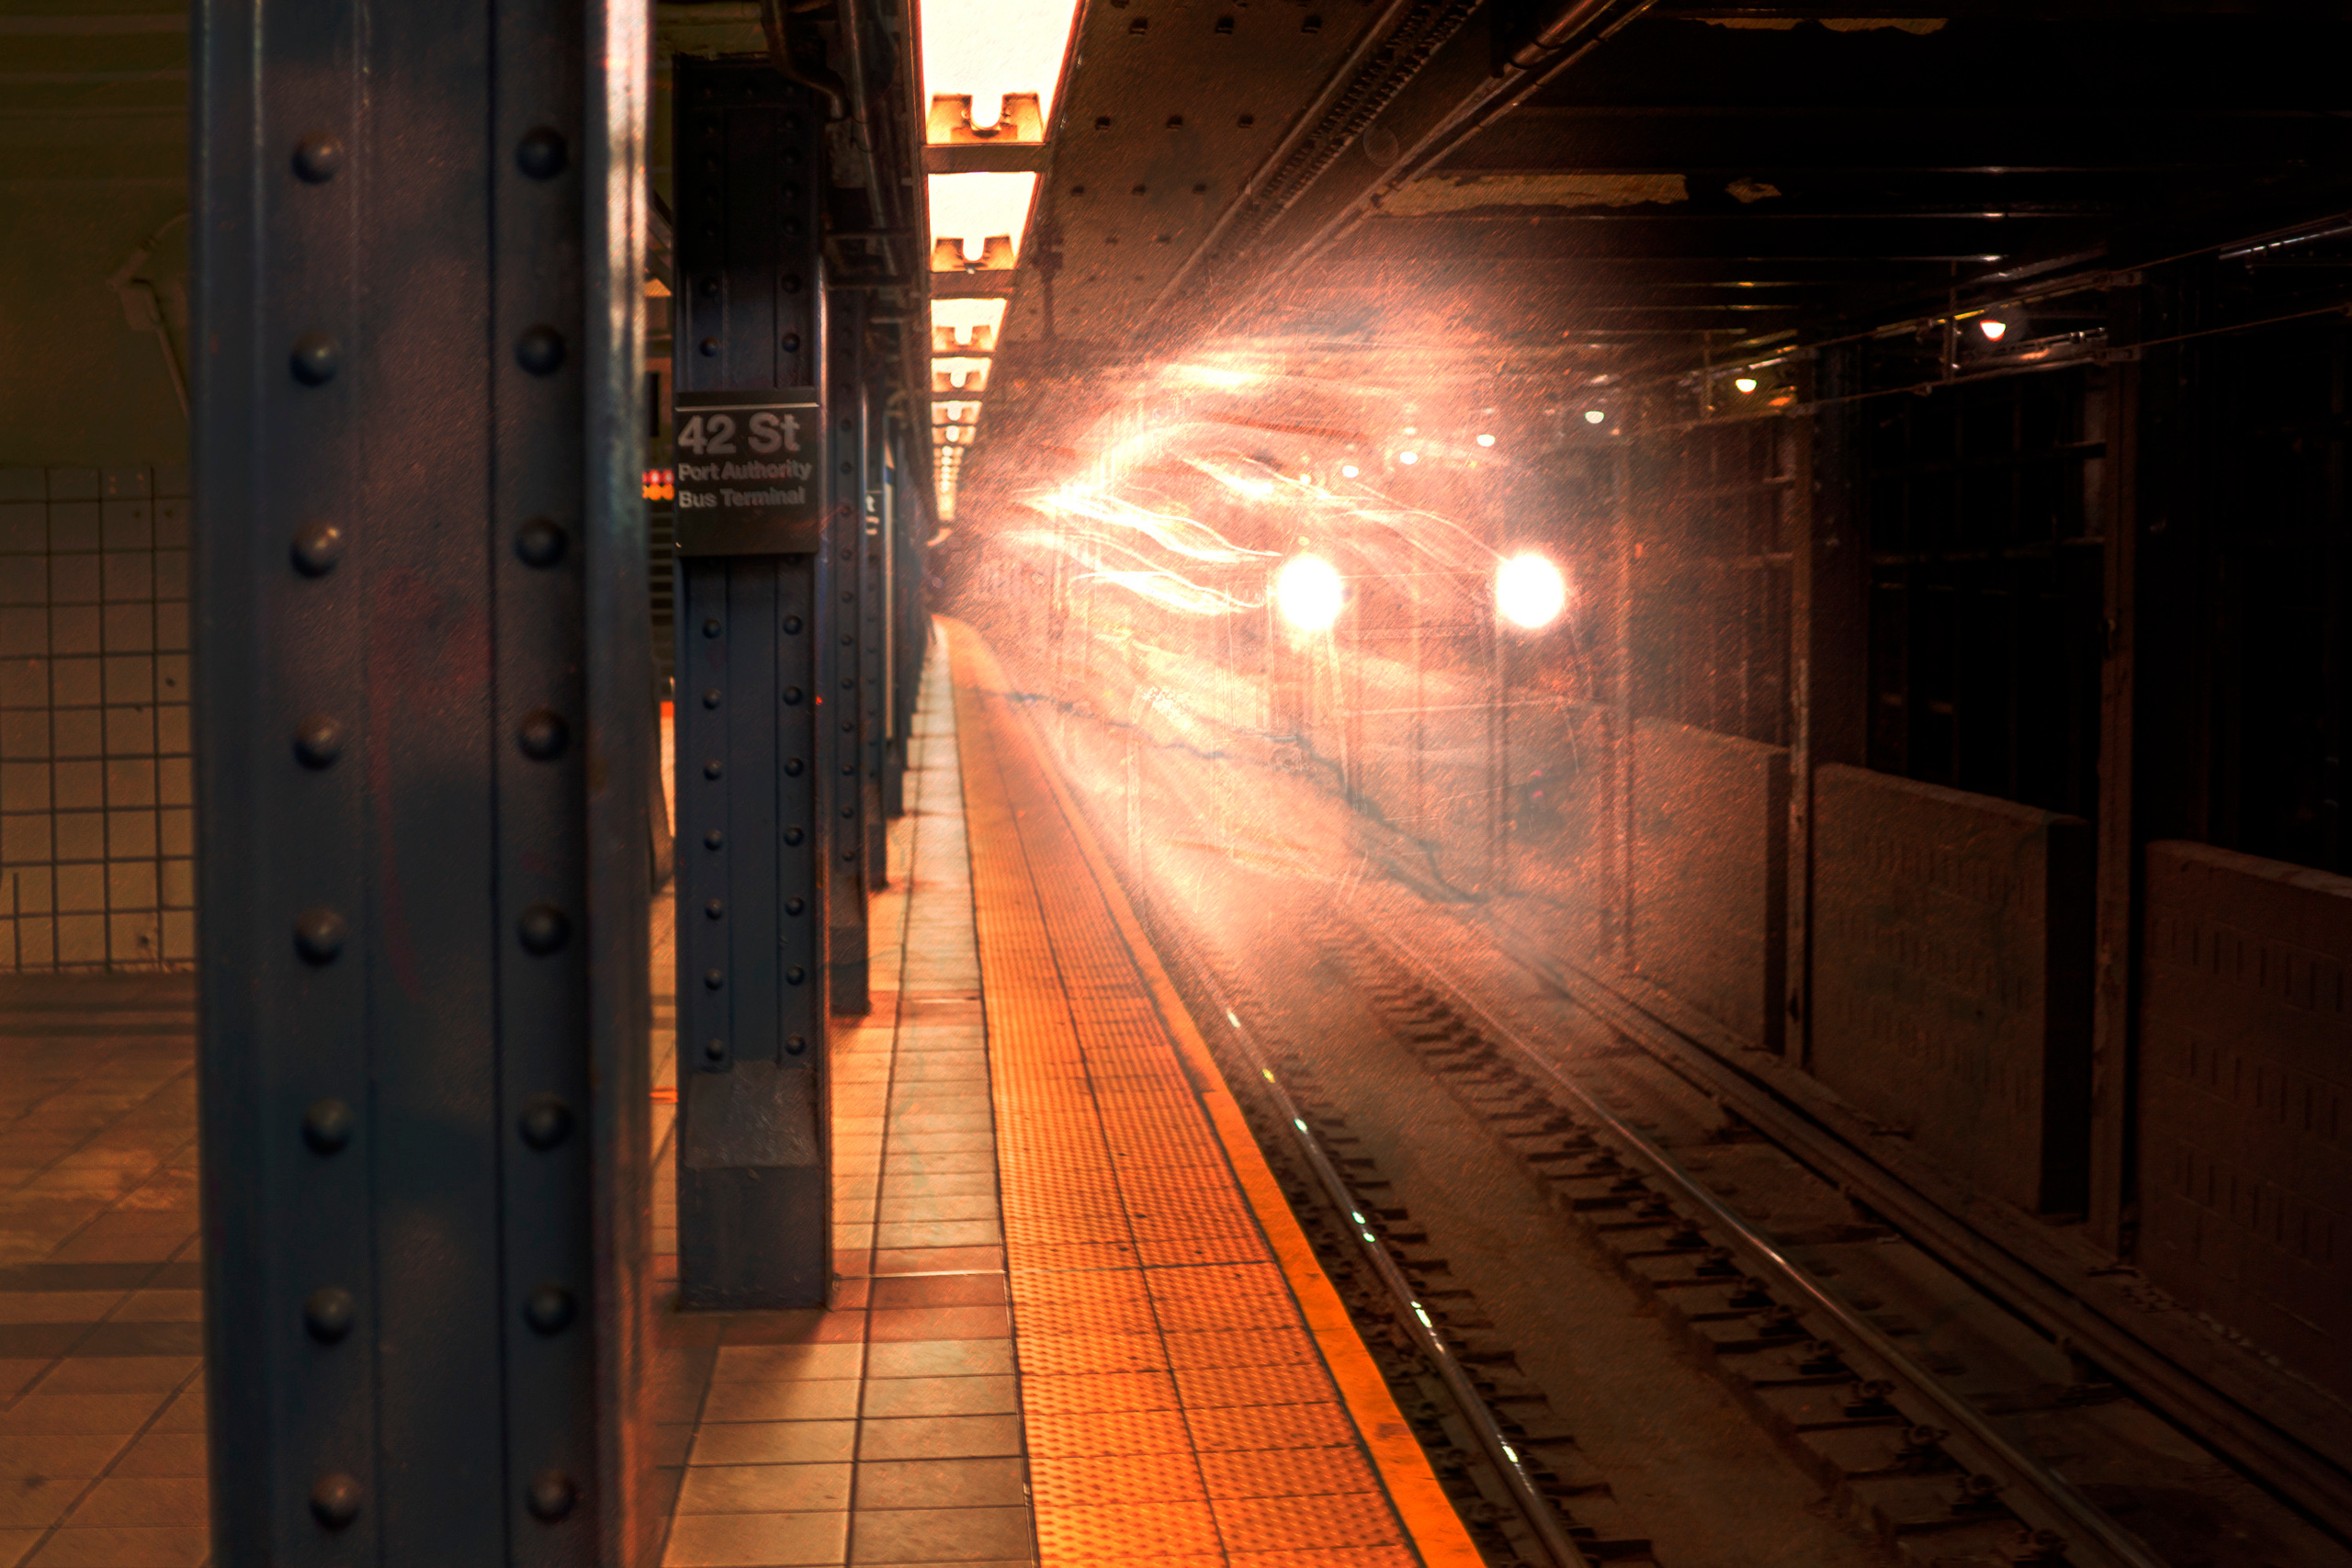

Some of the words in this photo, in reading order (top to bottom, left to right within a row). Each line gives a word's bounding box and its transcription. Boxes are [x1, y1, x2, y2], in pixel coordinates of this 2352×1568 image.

[677, 414, 736, 456] 42
[747, 412, 801, 454] St
[678, 462, 721, 482] Port
[721, 459, 813, 481] Authority
[678, 490, 718, 509] Bus
[719, 486, 806, 508] Terminal
